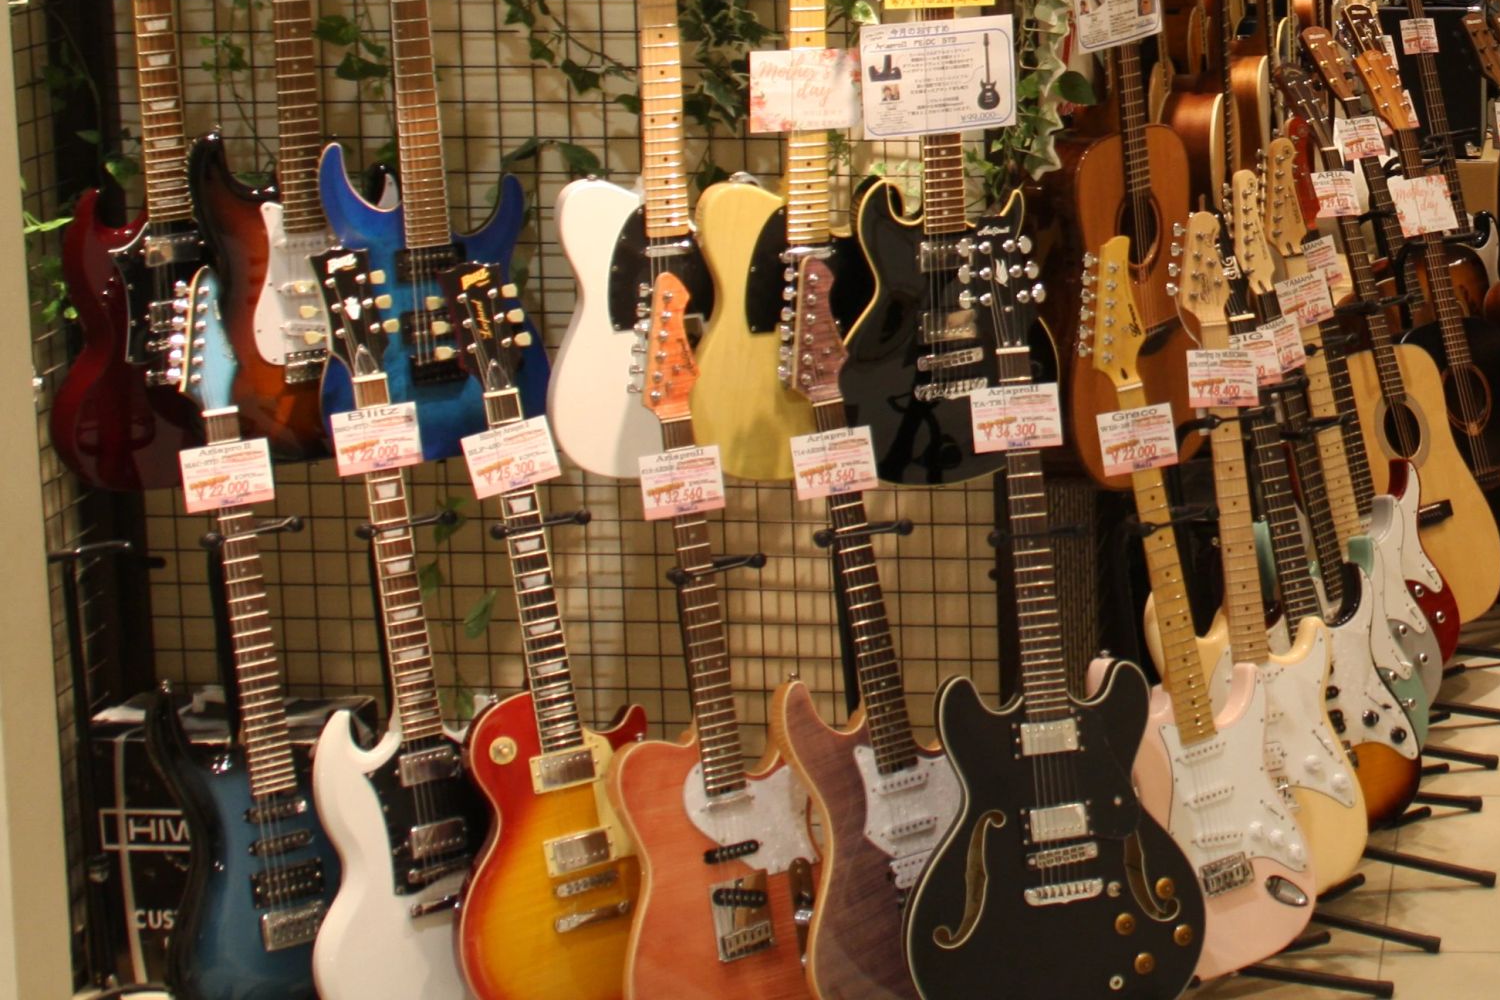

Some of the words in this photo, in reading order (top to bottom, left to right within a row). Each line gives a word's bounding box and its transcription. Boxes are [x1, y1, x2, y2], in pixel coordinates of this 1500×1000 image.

[797, 83, 834, 106] day
[1317, 172, 1345, 180] ARIA
[1284, 274, 1313, 288] YAMAHA
[347, 407, 400, 421] Blitz
[134, 909, 179, 930] CUS
